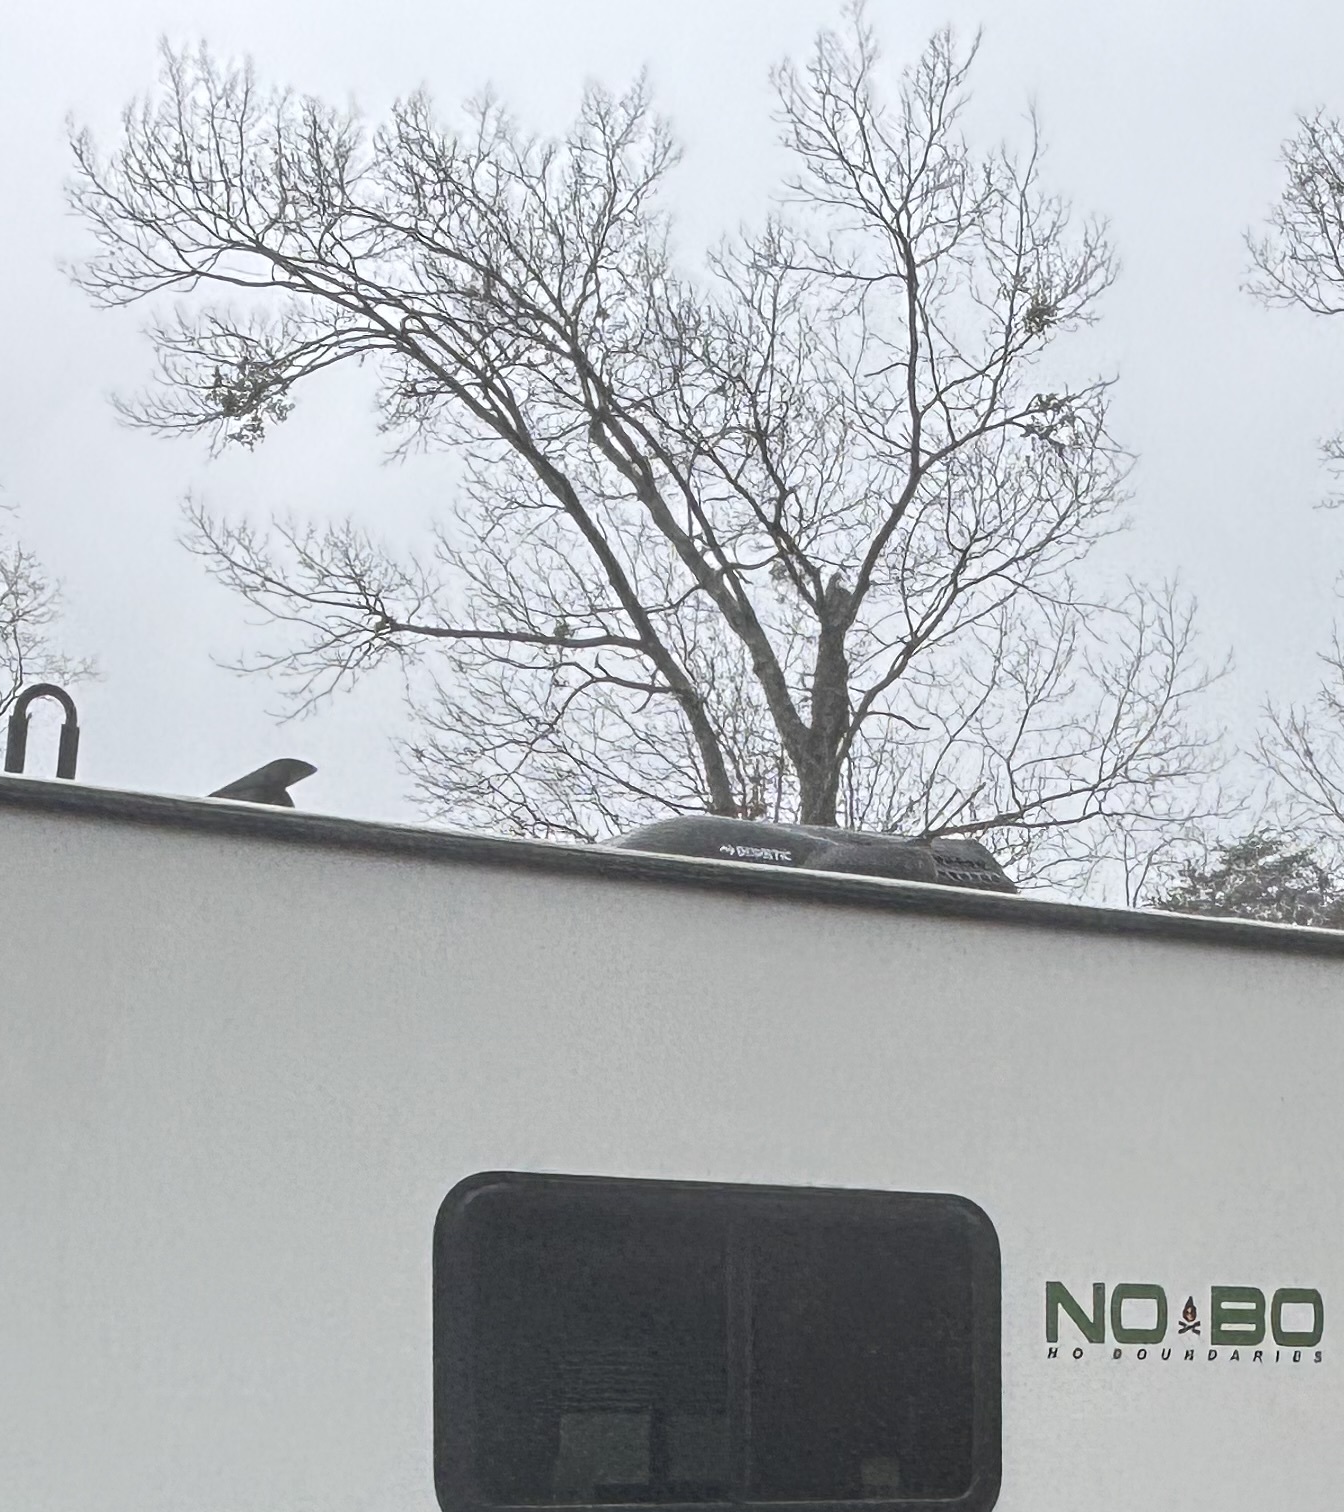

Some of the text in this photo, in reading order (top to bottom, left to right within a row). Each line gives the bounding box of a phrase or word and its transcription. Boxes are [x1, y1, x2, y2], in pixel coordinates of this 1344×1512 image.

[1046, 1281, 1324, 1347] NO BO
[1047, 1347, 1323, 1364] NO BOUNDARIES
